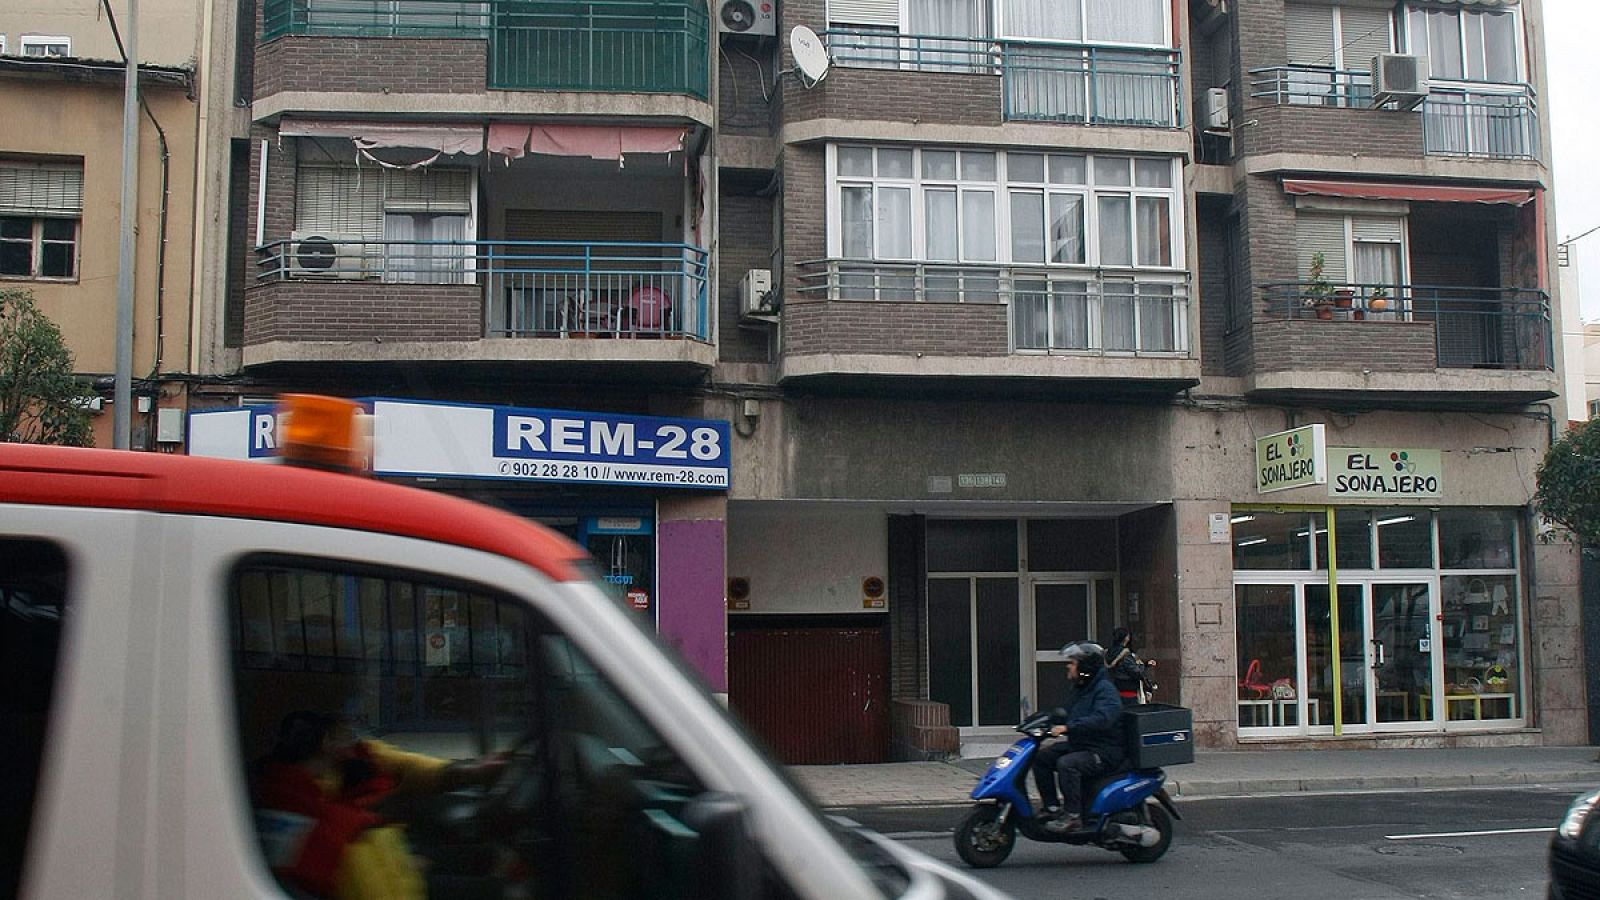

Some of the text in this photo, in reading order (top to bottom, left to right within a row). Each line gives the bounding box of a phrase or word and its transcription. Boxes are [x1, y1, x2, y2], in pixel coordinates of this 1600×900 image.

[507, 415, 721, 461] REM-28
[1266, 443, 1282, 462] EL
[1347, 453, 1379, 470] EL
[513, 462, 537, 476] 902
[543, 463, 558, 477] 28
[563, 465, 578, 478] 28
[584, 466, 598, 479] 10
[614, 469, 725, 484] www.rem-28.com
[1261, 458, 1314, 486] SONAJERO
[1335, 475, 1437, 493] SONAJERO
